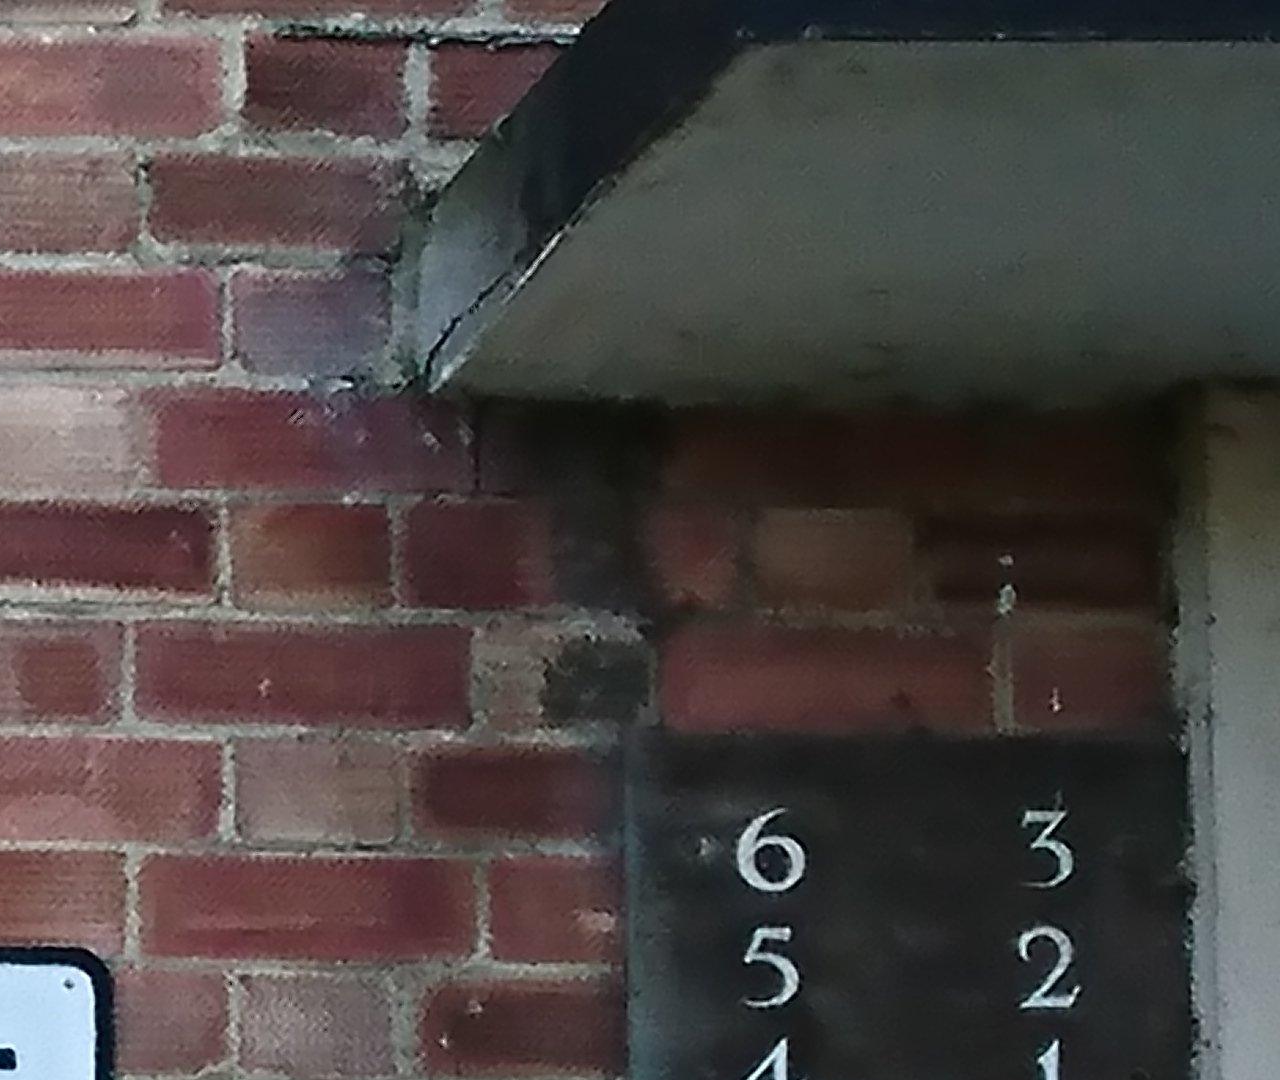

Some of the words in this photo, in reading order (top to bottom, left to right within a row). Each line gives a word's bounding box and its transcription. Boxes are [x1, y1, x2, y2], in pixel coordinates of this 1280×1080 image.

[735, 807, 807, 893] 6
[1020, 808, 1076, 890] 3
[742, 926, 801, 1009] 5
[1017, 925, 1082, 1010] 2
